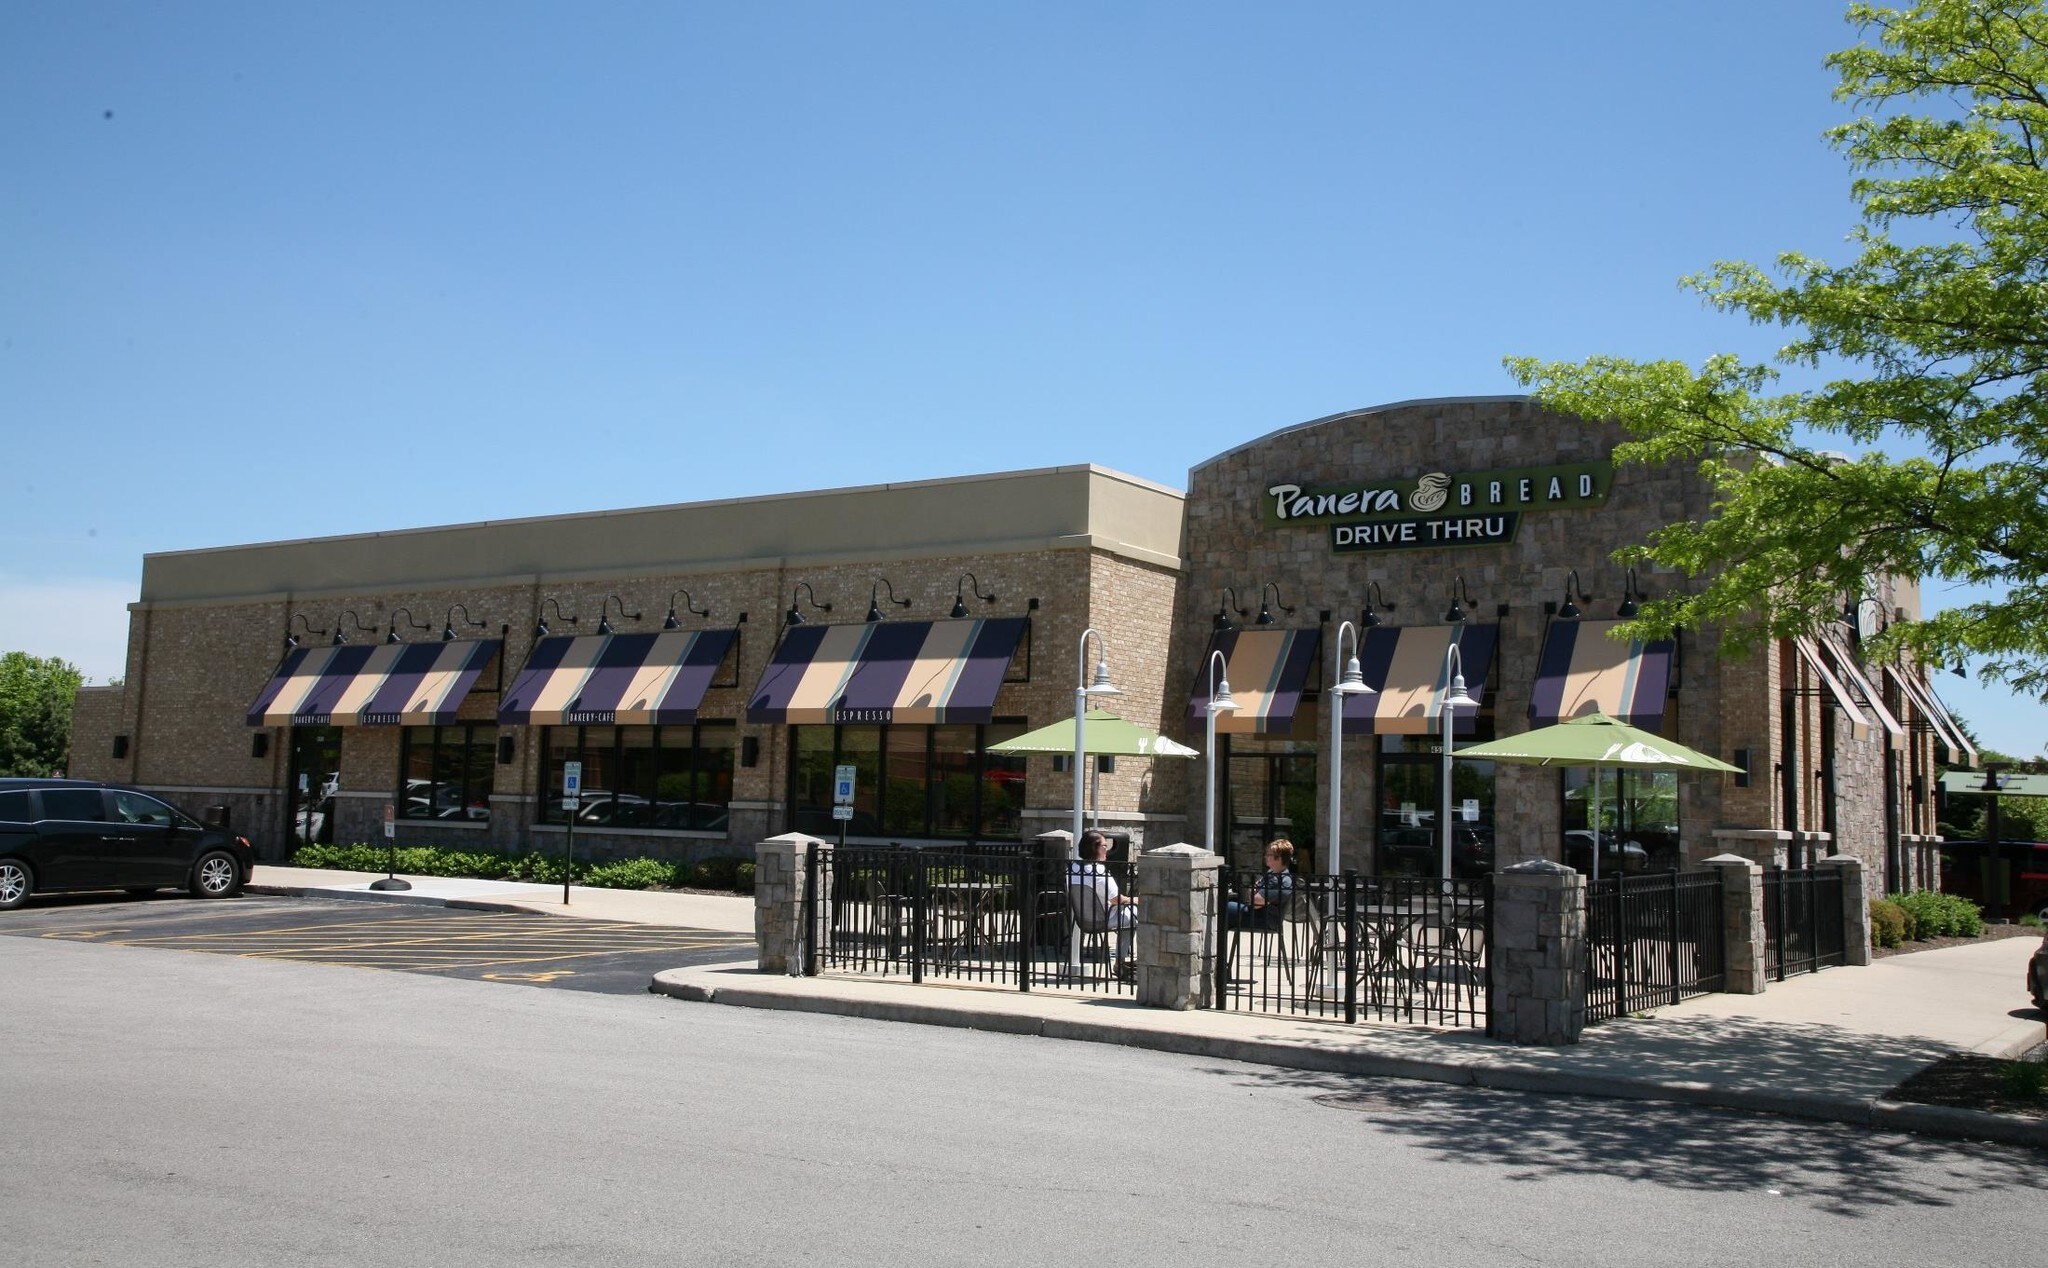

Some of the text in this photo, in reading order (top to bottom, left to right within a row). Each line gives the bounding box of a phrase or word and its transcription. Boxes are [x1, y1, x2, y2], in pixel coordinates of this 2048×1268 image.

[1269, 474, 1592, 519] Panera BREAD
[1336, 517, 1504, 545] DRIVE THRU
[363, 714, 400, 723] ESPRESSO
[836, 710, 891, 720] ESPRESSO
